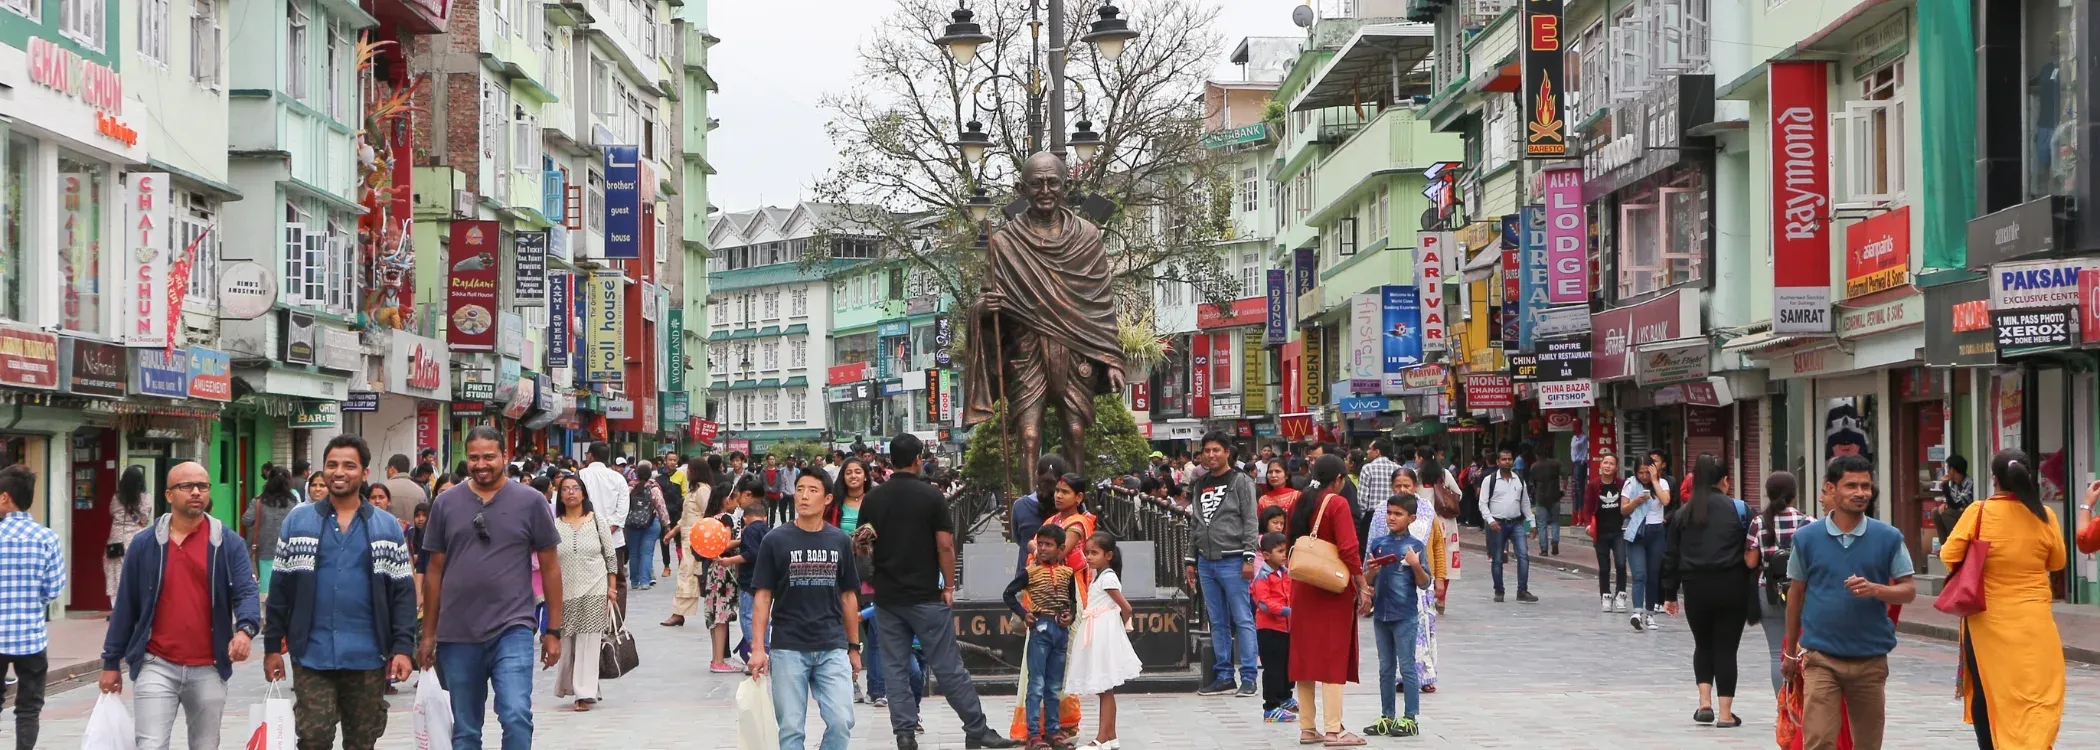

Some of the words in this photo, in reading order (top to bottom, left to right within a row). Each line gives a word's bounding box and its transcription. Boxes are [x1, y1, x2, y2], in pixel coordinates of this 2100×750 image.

[28, 36, 70, 97] CHAI
[81, 59, 122, 116] CHUN
[1550, 173, 1578, 188] ALFA
[1777, 107, 1825, 242] Raymond
[606, 180, 636, 190] brothers'
[137, 176, 154, 246] CHAI
[610, 207, 629, 216] guest
[611, 233, 631, 242] house
[1554, 193, 1582, 295] LODGE
[1863, 235, 1894, 266] asianpaints
[236, 280, 259, 288] REMO'S
[452, 277, 494, 290] Rajdhani
[2001, 267, 2082, 291] PAKSAM
[228, 287, 267, 296] AMUSEMENT
[553, 278, 562, 310] LAXMI
[1423, 237, 1442, 339] PARIVAR
[137, 265, 153, 334] CHUN
[600, 280, 615, 332] house
[2003, 294, 2049, 304] EXCLUSIVE
[1272, 289, 1281, 327] DZONG
[1780, 308, 1825, 323] SAMRAT
[1997, 316, 2001, 326] 1
[2003, 316, 2020, 326] MIN.
[2020, 314, 2039, 325] PASS
[2040, 312, 2065, 323] PHOTO
[553, 314, 562, 354] SWEETS
[1357, 297, 1378, 378] firstcry
[1650, 321, 1668, 342] BANK
[1998, 323, 2066, 337] XEROX
[2014, 336, 2033, 344] DONE
[2033, 335, 2051, 343] HERE
[600, 341, 615, 370] roll
[672, 330, 680, 384] WOODLAND
[1513, 357, 1537, 365] CHINA
[1539, 353, 1558, 361] FAMILY
[1558, 352, 1592, 360] RESTAURANT
[1681, 355, 1702, 365] Flight
[1409, 367, 1441, 378] PARIVAR
[1519, 366, 1537, 375] GIFT
[193, 379, 228, 394] AMUSEMENT
[1195, 369, 1203, 397] kotak
[1307, 354, 1319, 406] GOLDEN
[1469, 376, 1511, 386] MONEY
[465, 391, 494, 399] STUDIO
[1541, 385, 1564, 393] CHINA
[1566, 383, 1590, 392] BAZAR
[1547, 393, 1586, 401] GIFTSHOP
[1349, 400, 1380, 410] vivo
[297, 414, 322, 423] BAR
[790, 550, 803, 562] MY
[807, 550, 828, 562] ROAD
[830, 550, 839, 562] TO
[789, 562, 838, 582] SUCCESS
[971, 614, 991, 636] G.
